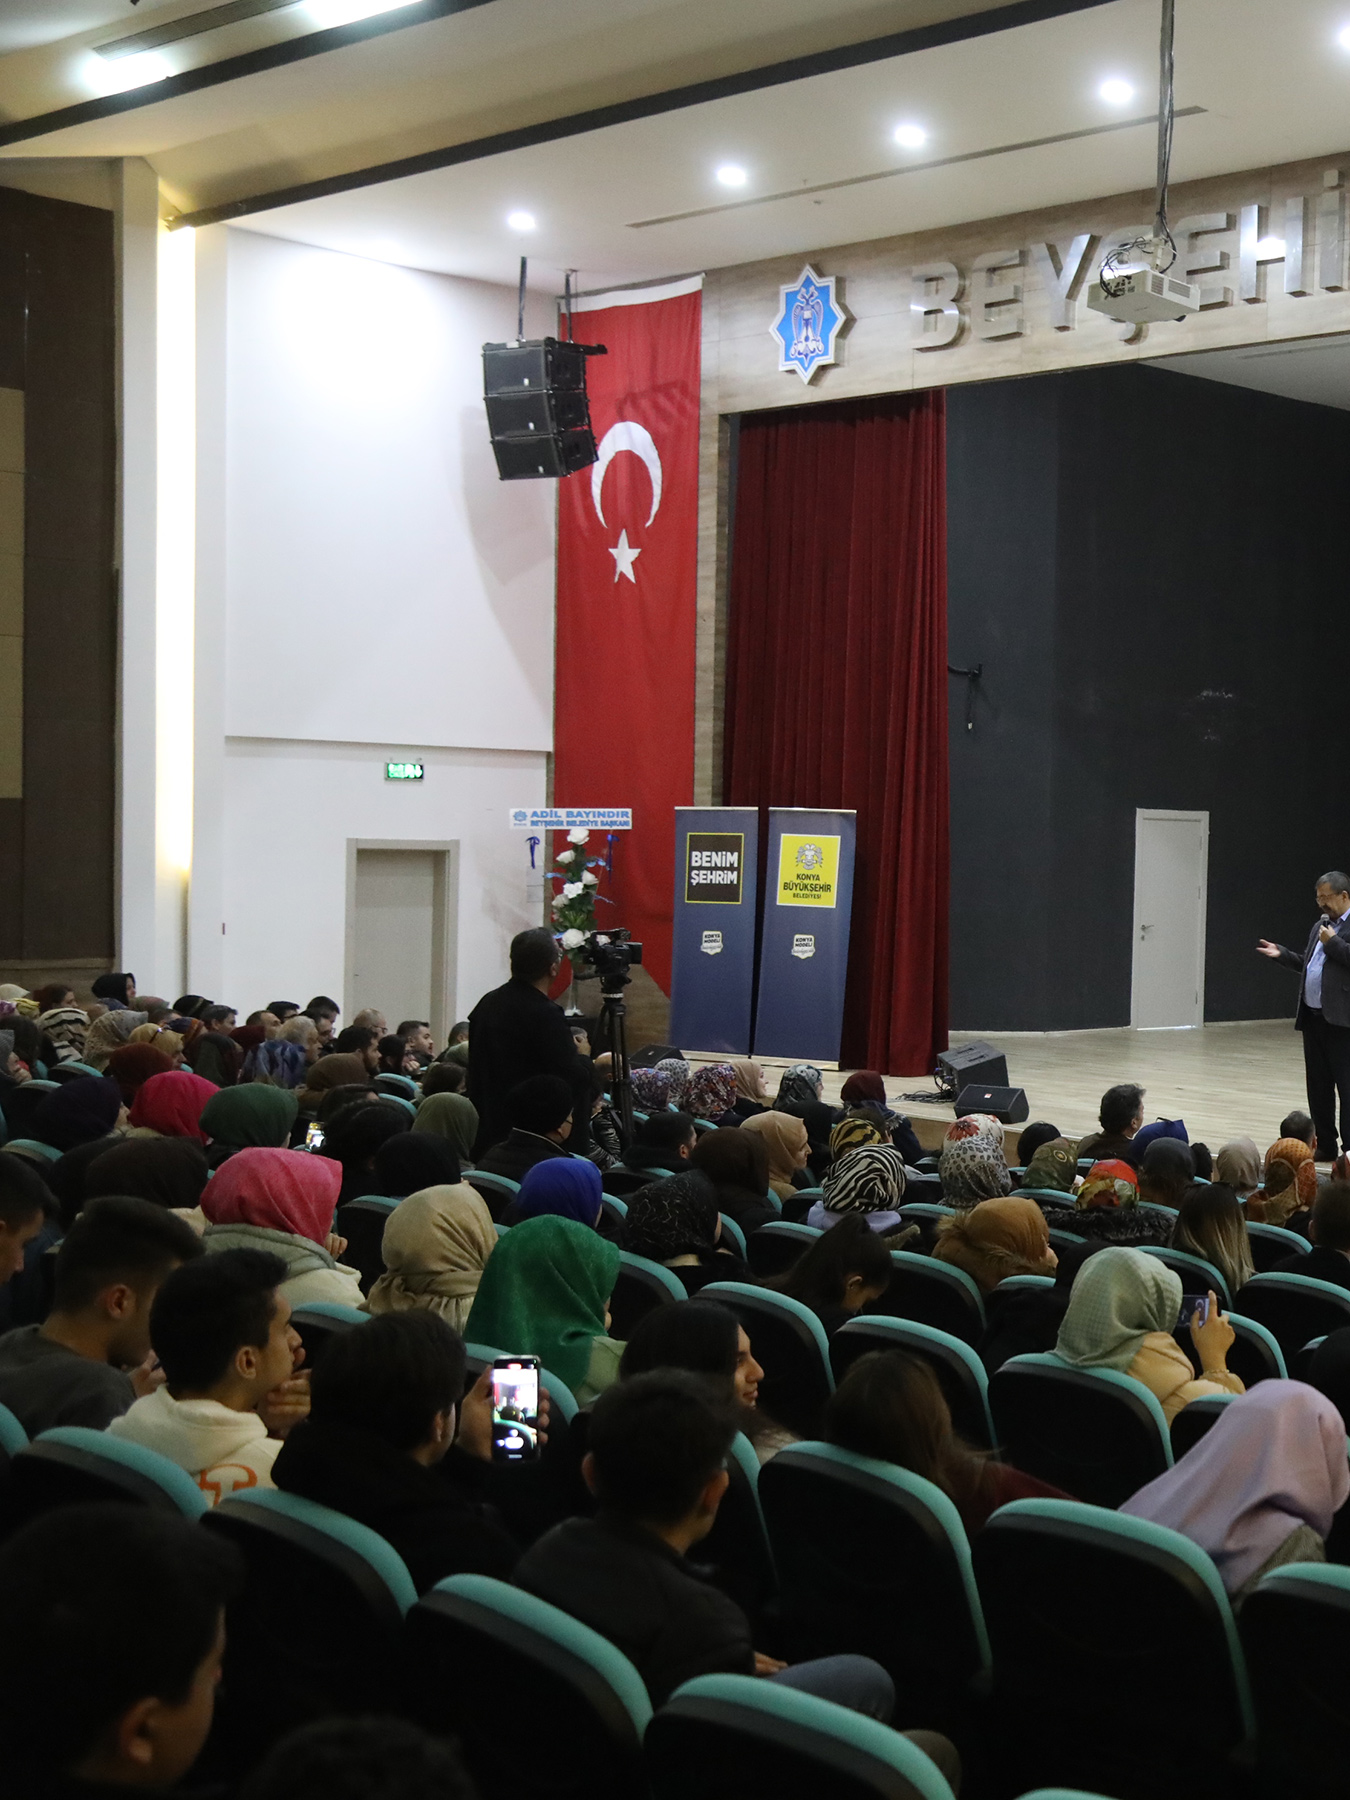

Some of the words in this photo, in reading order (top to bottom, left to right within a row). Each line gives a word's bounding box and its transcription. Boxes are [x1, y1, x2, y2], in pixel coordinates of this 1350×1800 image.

[530, 809, 562, 819] ADİL
[566, 810, 630, 819] BAYINDIR
[796, 873, 821, 881] KONYA
[783, 880, 832, 893] BÜYÜKŞEHİR
